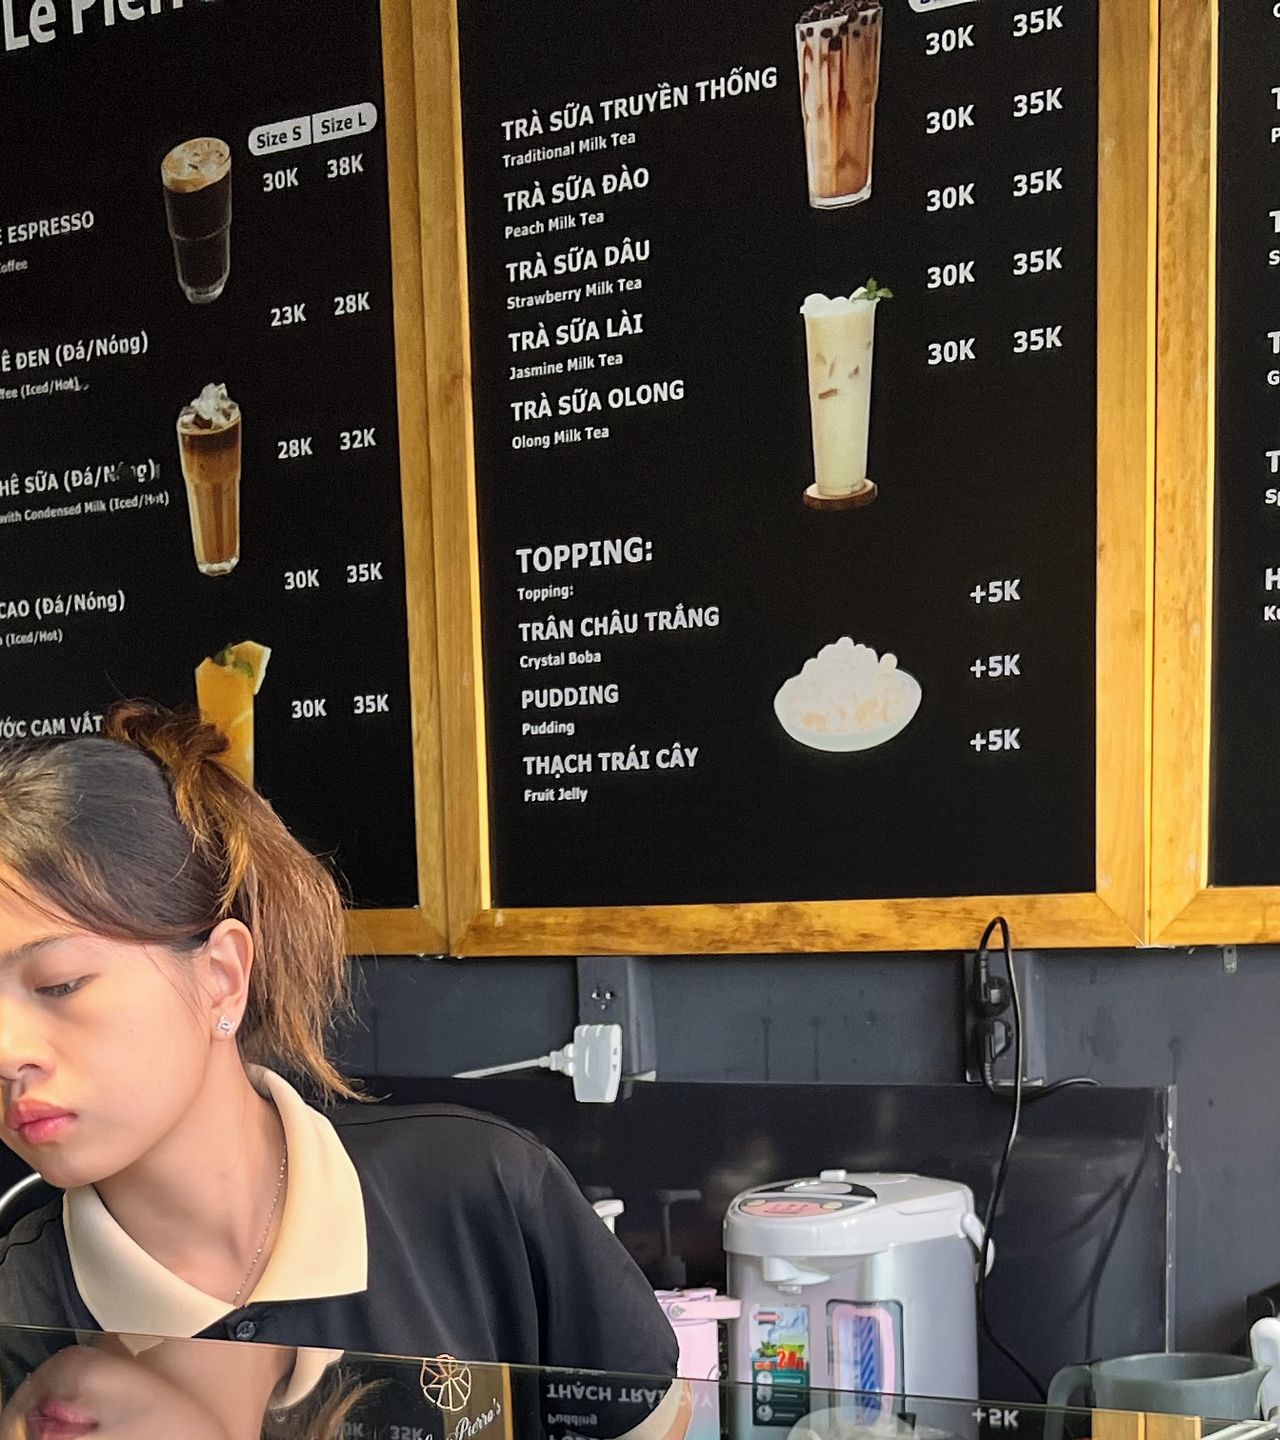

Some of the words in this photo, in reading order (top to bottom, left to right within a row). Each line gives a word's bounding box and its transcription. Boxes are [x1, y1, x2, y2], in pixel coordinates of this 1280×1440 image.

[1014, 6, 1062, 36] 35K
[926, 25, 974, 55] 30K
[501, 109, 543, 140] TRÀ
[550, 102, 593, 131] SỮA
[600, 83, 688, 121] TRUYỀN
[696, 67, 776, 101] THỐNG
[1014, 88, 1062, 117] 35K
[322, 118, 352, 135] Size
[358, 112, 366, 126] L
[927, 105, 974, 133] 30K
[257, 132, 287, 149] Size
[293, 126, 301, 141] S
[502, 141, 574, 167] Traditional
[579, 136, 607, 153] Milk
[611, 132, 635, 146] Tea
[327, 154, 363, 178] 38K
[263, 168, 298, 191] 30K
[504, 181, 545, 212] TRÀ
[552, 175, 595, 203] SỮA
[602, 164, 648, 194] ĐÀO
[1013, 168, 1062, 196] 35K
[927, 183, 974, 211] 30K
[8, 211, 94, 243] ESPRESSO
[505, 221, 544, 239] Peach
[549, 215, 576, 231] Milk
[580, 212, 604, 225] Tea
[506, 252, 547, 282] TRÀ
[554, 246, 597, 274] SỮA
[605, 237, 649, 266] DÂU
[1014, 247, 1062, 275] 35K
[928, 261, 974, 288] 30K
[335, 292, 370, 315] 28K
[507, 289, 581, 309] Strawberry
[586, 281, 613, 297] Milk
[617, 279, 642, 291] Tea
[271, 303, 306, 326] 23K
[508, 322, 549, 352] TRÀ
[556, 317, 600, 345] SỮA
[607, 309, 643, 337] LÀI
[1014, 326, 1062, 352] 35K
[16, 348, 49, 369] ĐEN
[56, 331, 148, 367] (Đá/Nóng)
[928, 338, 975, 364] 30K
[510, 362, 563, 380] Jasmine
[568, 356, 594, 371] Milk
[598, 354, 623, 366] Tea
[511, 392, 552, 421] TRÀ
[559, 388, 602, 415] SỮA
[608, 380, 684, 408] OLONG
[278, 437, 312, 459] 28K
[340, 428, 376, 450] 32K
[512, 435, 550, 449] Olong
[554, 428, 581, 444] Milk
[585, 427, 609, 439] Tea
[25, 471, 58, 493] SỮA
[0, 511, 21, 523] with
[24, 503, 81, 521] Condensed
[84, 500, 106, 513] Milk
[516, 537, 652, 573] TOPPING:
[285, 569, 319, 589] 30K
[347, 562, 382, 583] 35K
[517, 585, 573, 602] Topping:
[970, 579, 1020, 603] +5K
[35, 590, 125, 620] (Đá/Nóng)
[519, 615, 573, 641] TRÂN
[581, 609, 637, 636] CHÂU
[644, 603, 719, 631] TRẮNG
[520, 652, 564, 670] Crystal
[569, 650, 601, 664] Boba
[970, 654, 1020, 677] +5K
[292, 699, 327, 718] 30K
[354, 694, 389, 714] 35K
[522, 684, 618, 709] PUDDING
[31, 718, 65, 736] CAM
[523, 721, 574, 735] Pudding
[970, 728, 1020, 751] +5K
[523, 754, 592, 778] THẠCH
[598, 745, 650, 771] TRÁI
[656, 743, 698, 768] CÂY
[525, 788, 555, 801] Fruit
[558, 787, 588, 802] Jelly
